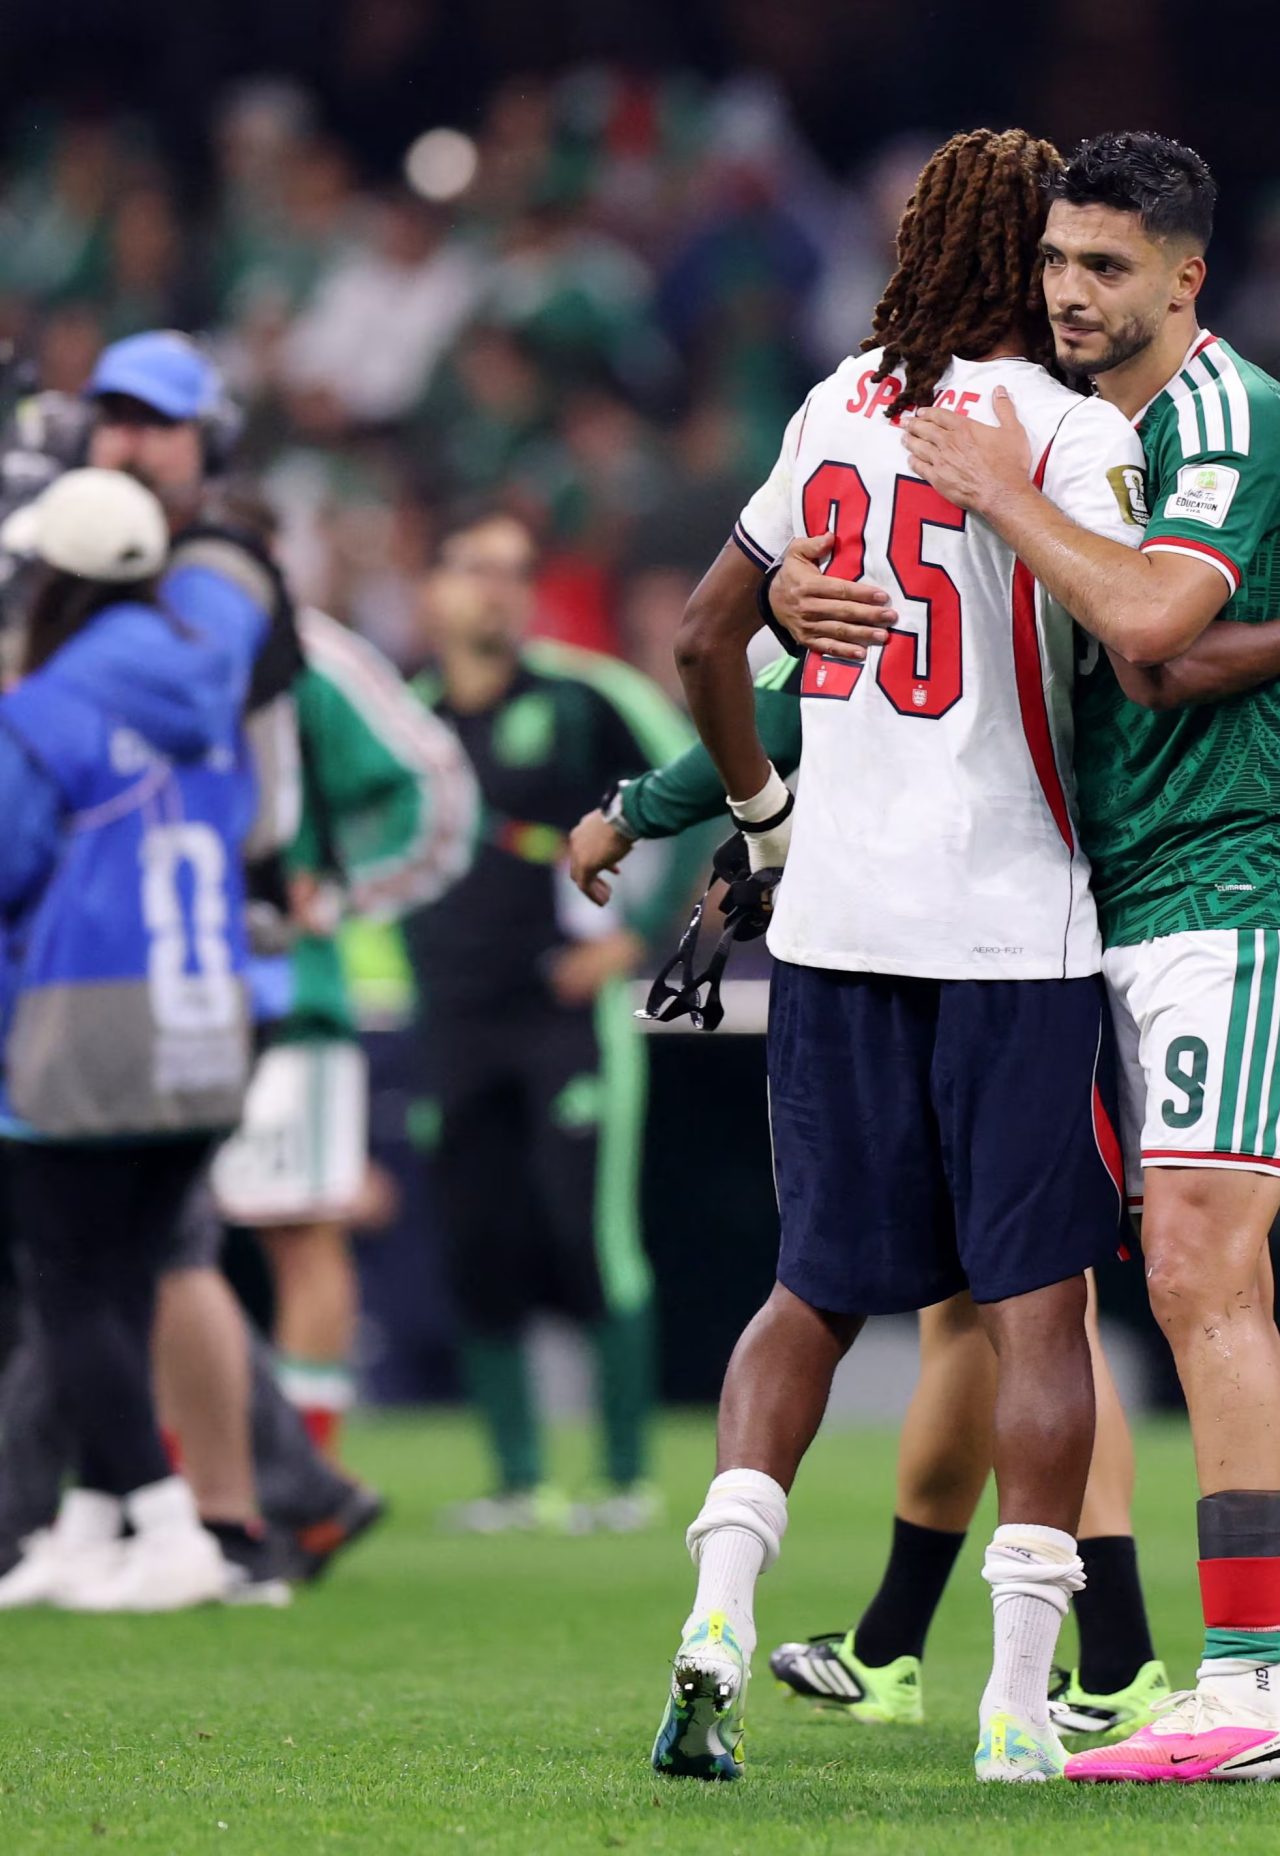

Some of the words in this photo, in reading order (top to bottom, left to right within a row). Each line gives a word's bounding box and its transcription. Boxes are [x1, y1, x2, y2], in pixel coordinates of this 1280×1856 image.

[1176, 496, 1218, 512] EDUCATION
[800, 459, 967, 720] 25
[972, 946, 1024, 954] AERO-FIT
[1162, 1035, 1209, 1129] 9
